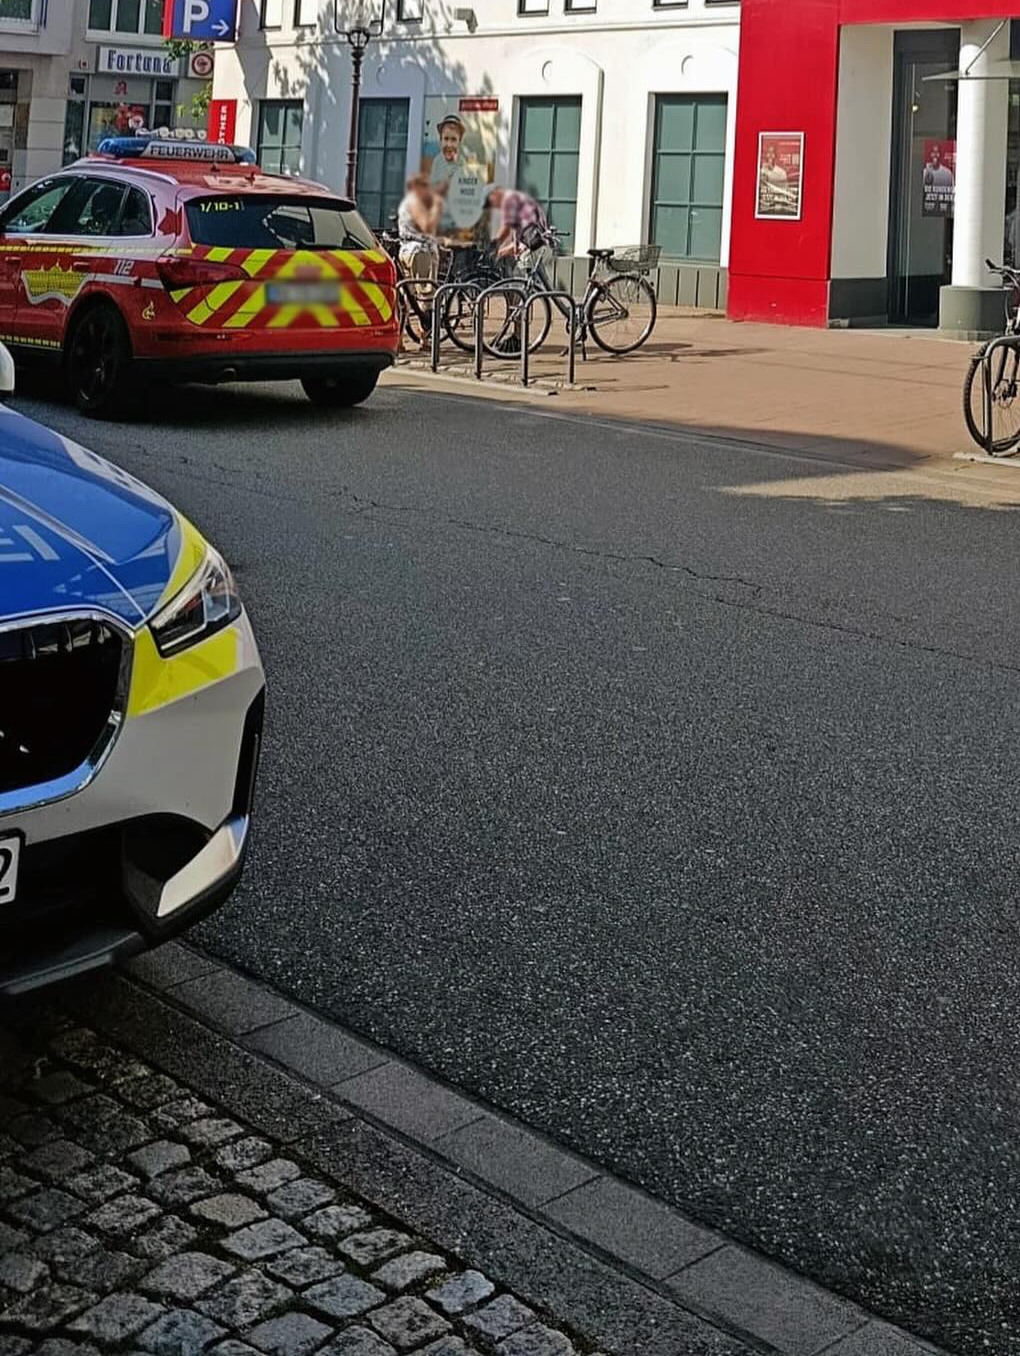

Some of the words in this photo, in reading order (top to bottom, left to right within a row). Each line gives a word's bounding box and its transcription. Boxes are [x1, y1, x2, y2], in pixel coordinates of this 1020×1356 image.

[107, 49, 172, 73] Fortuna
[150, 145, 229, 159] FEUERWEHR
[114, 260, 134, 275] 112
